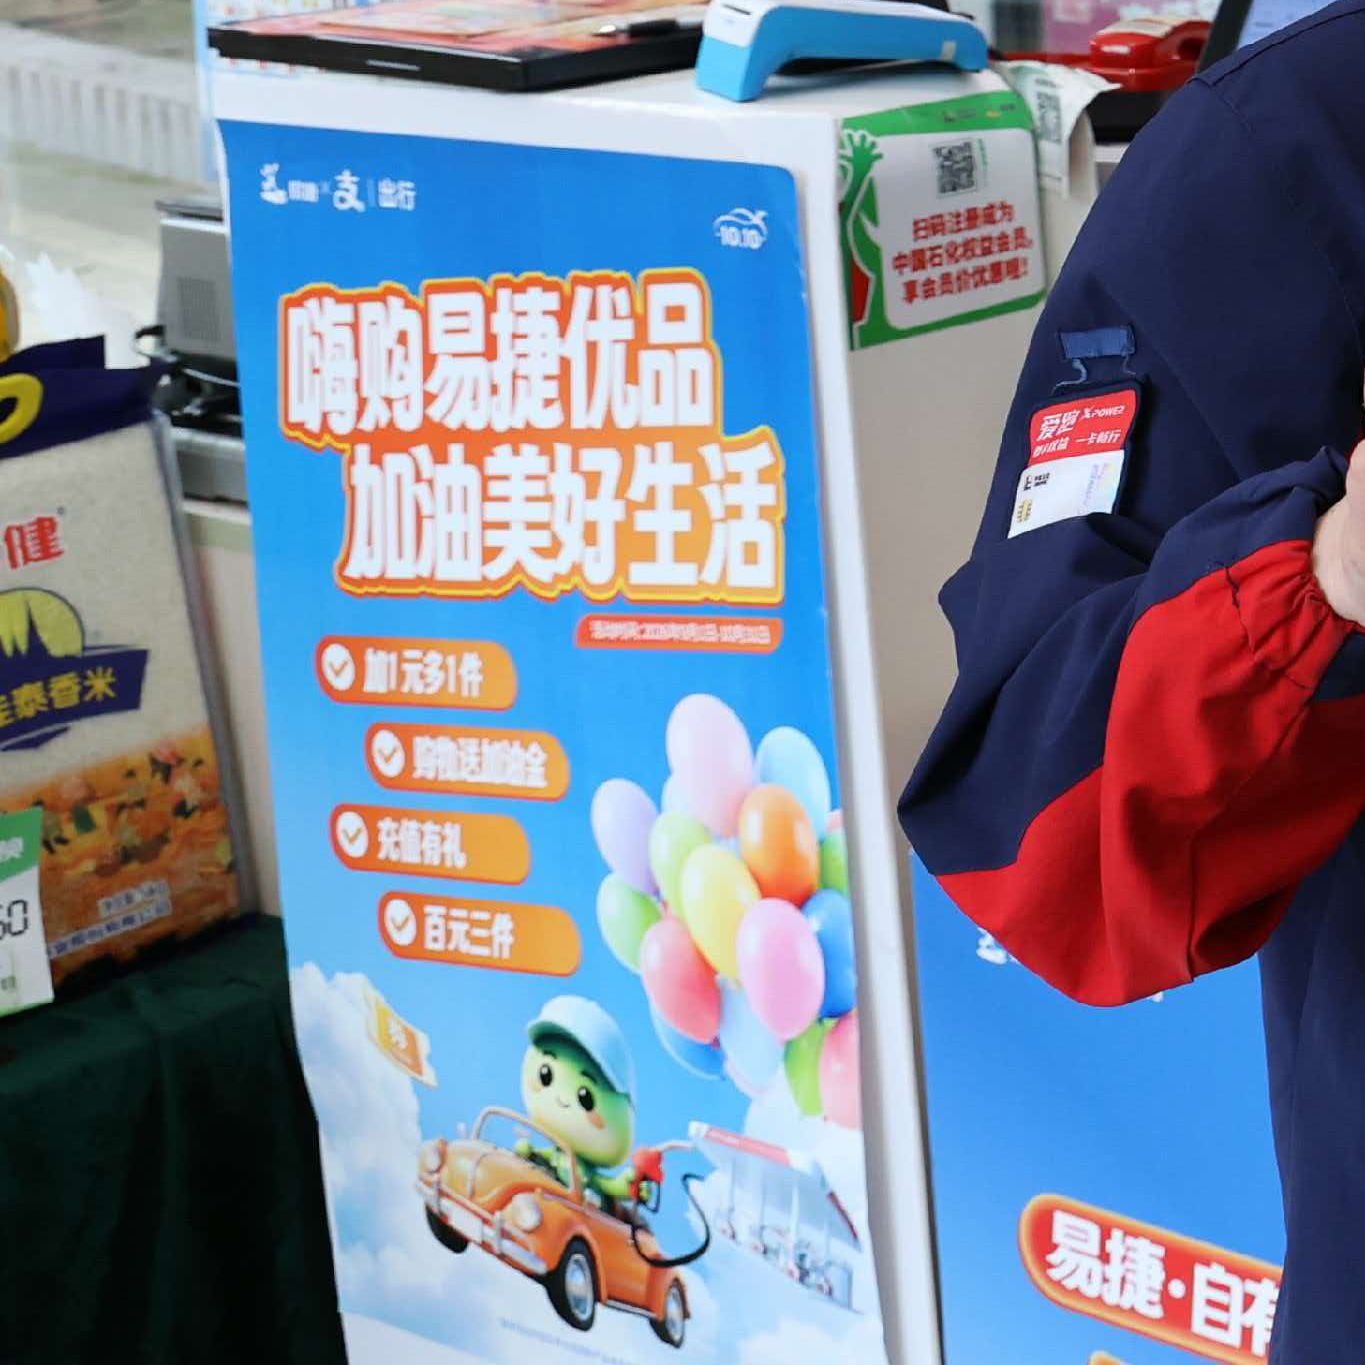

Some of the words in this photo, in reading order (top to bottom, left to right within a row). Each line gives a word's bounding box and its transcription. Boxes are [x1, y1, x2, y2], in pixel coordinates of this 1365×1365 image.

[286, 281, 714, 434] 嗨购易捷优品
[341, 440, 778, 589] 加油美好生活
[376, 817, 467, 870] 充值有礼
[423, 901, 515, 959] 百元三件
